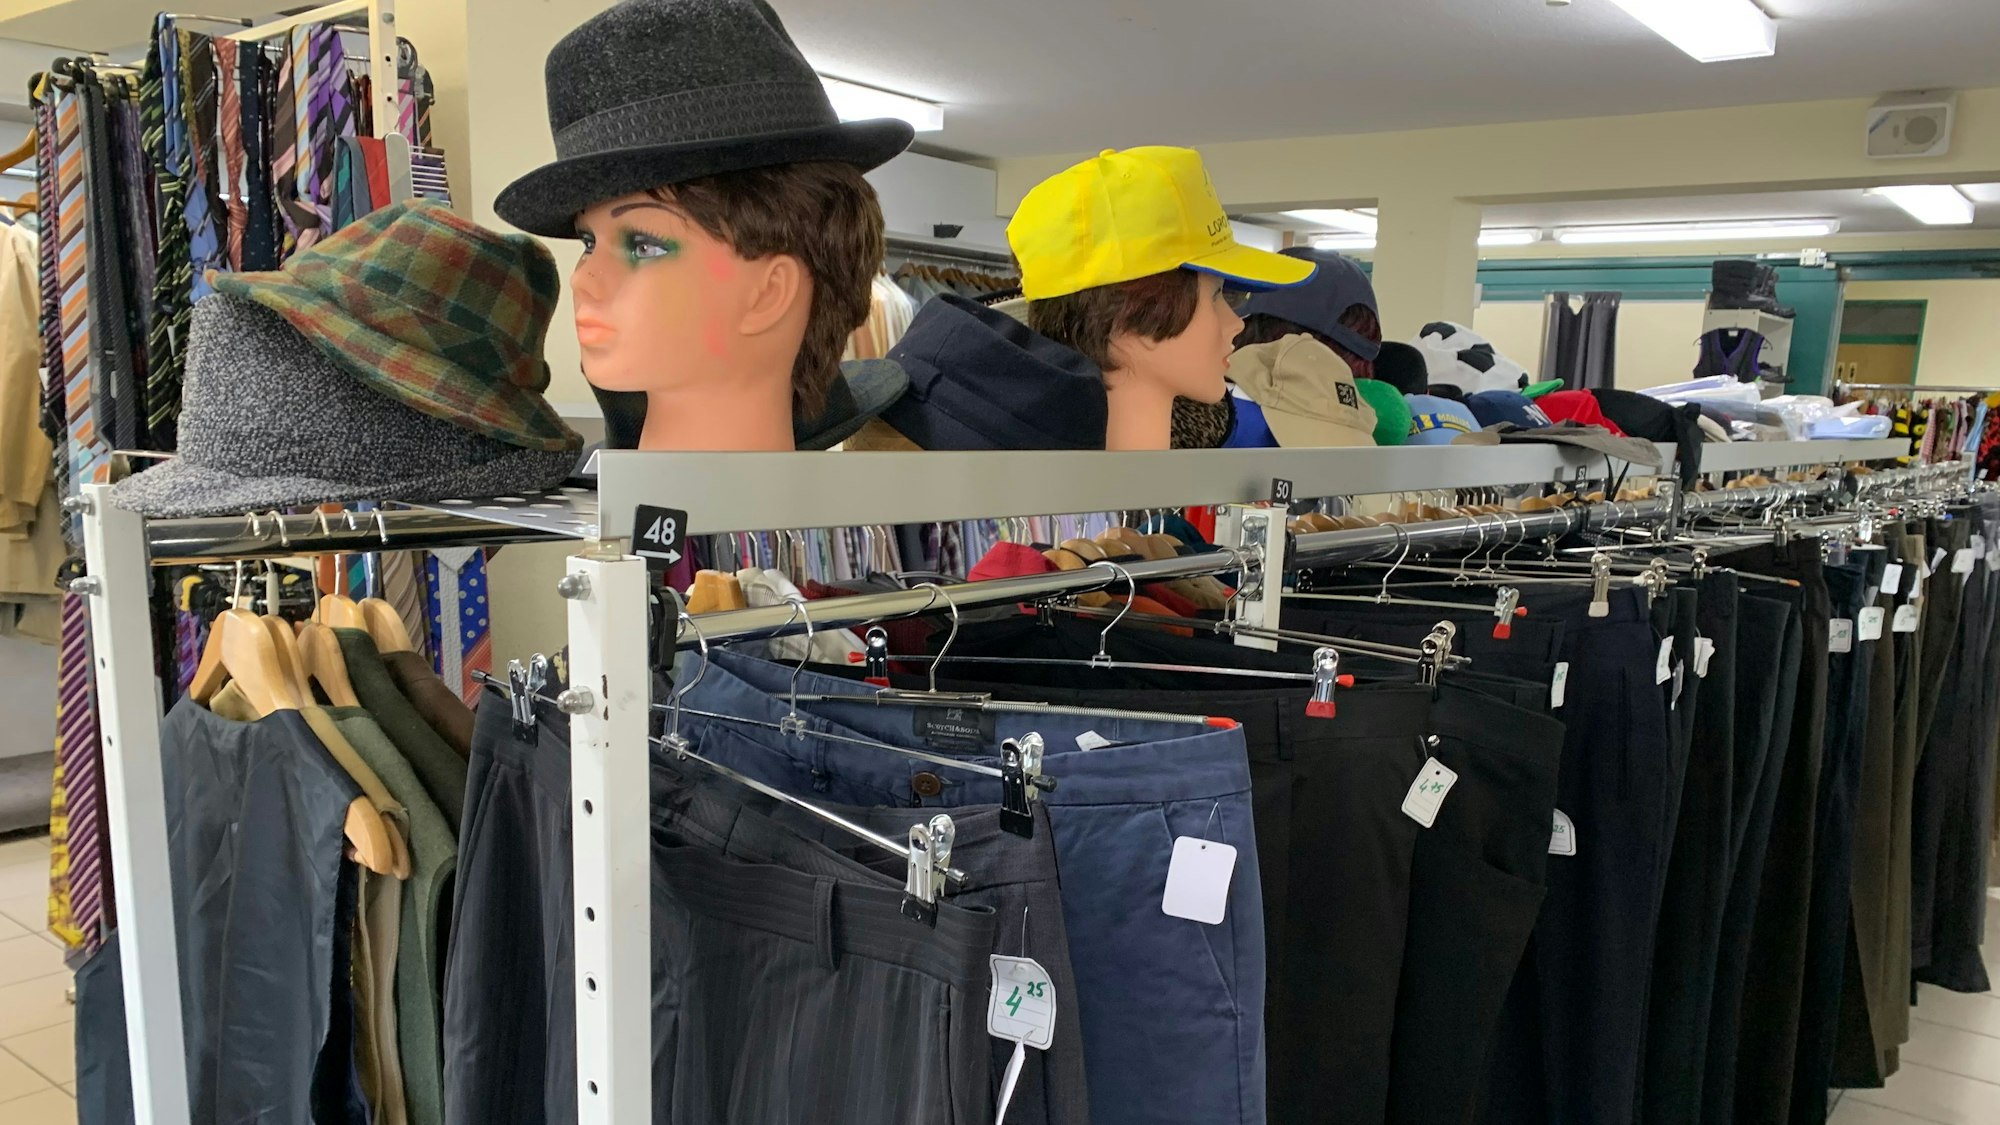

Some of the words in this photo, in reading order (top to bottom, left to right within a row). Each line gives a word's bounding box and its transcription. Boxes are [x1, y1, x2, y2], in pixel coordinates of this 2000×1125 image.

[1275, 481, 1289, 499] 50
[643, 515, 676, 546] 48
[1005, 986, 1022, 1017] 4
[1026, 981, 1048, 998] 25
